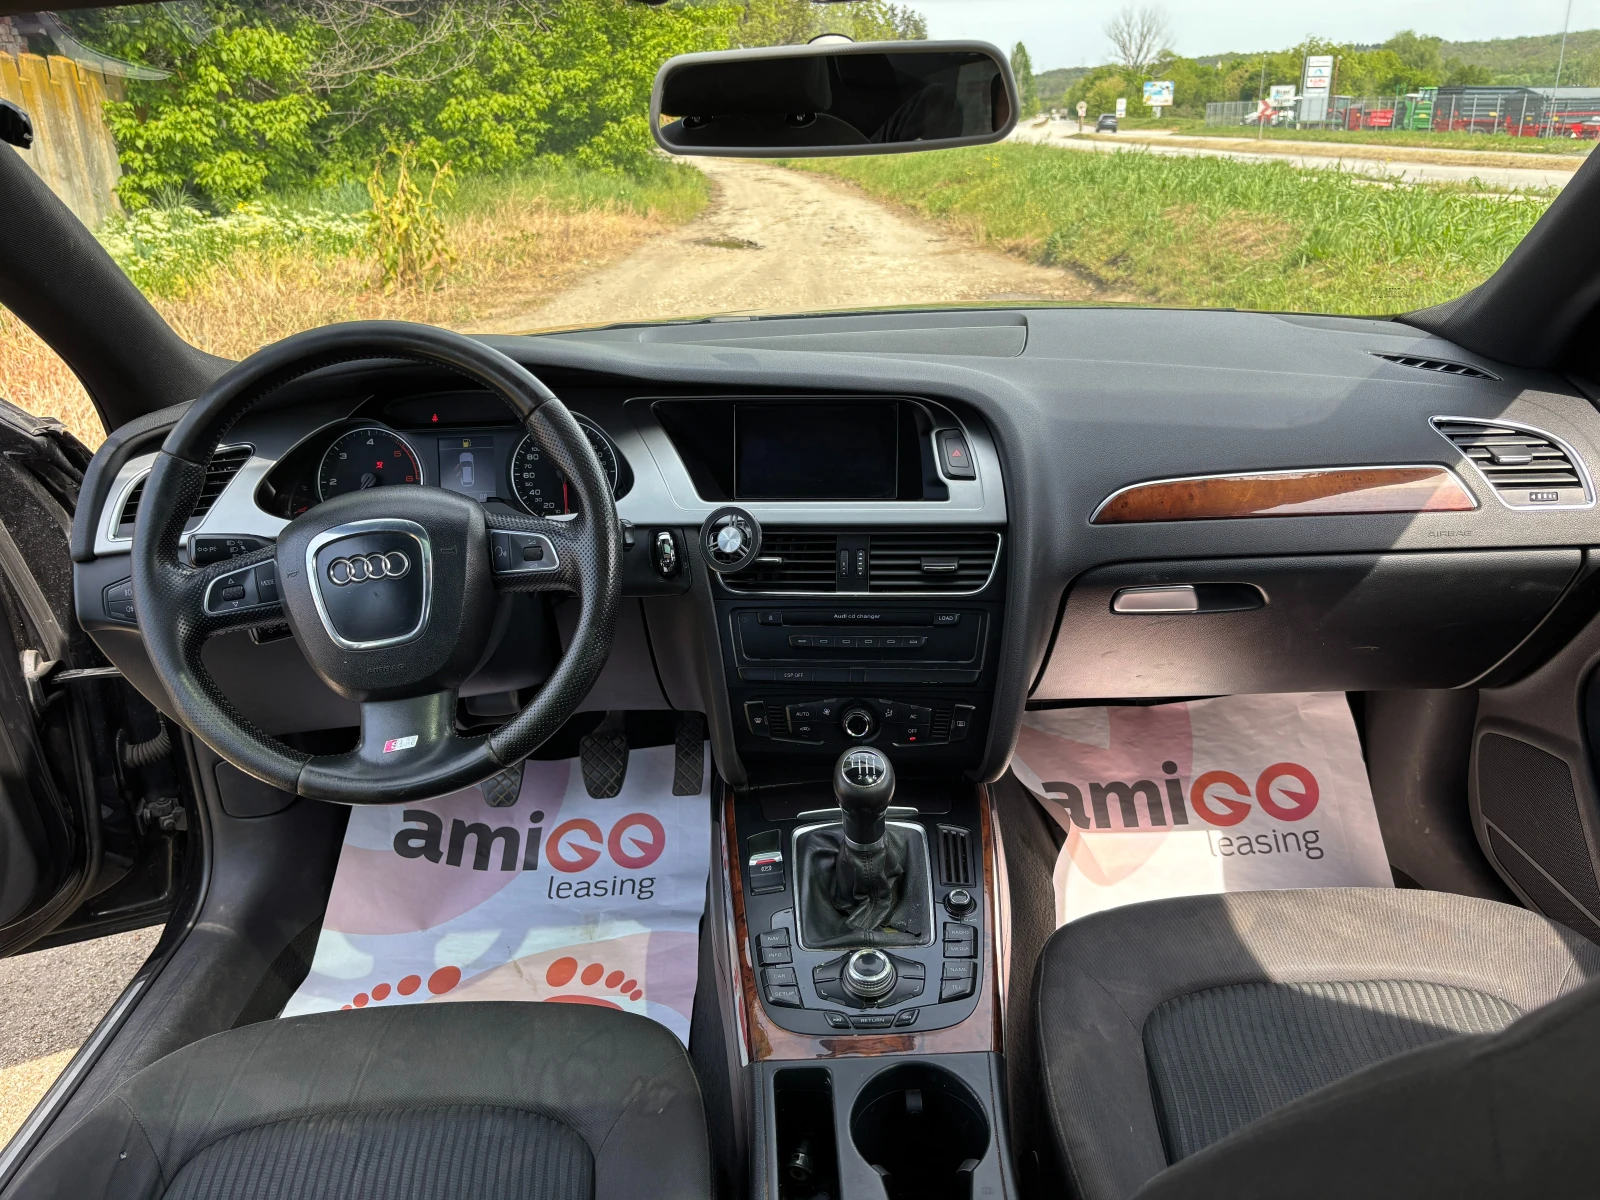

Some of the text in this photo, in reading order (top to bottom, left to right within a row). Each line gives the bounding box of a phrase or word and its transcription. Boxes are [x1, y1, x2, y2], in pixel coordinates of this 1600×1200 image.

[366, 438, 375, 446] 4
[339, 452, 348, 460] 3
[393, 450, 402, 458] 5
[526, 453, 540, 461] 80
[329, 478, 338, 486] 2
[405, 475, 414, 483] 6
[260, 578, 276, 587] MODE
[856, 613, 881, 621] changer
[1206, 828, 1325, 860] leasing
[547, 875, 656, 900] leasing
